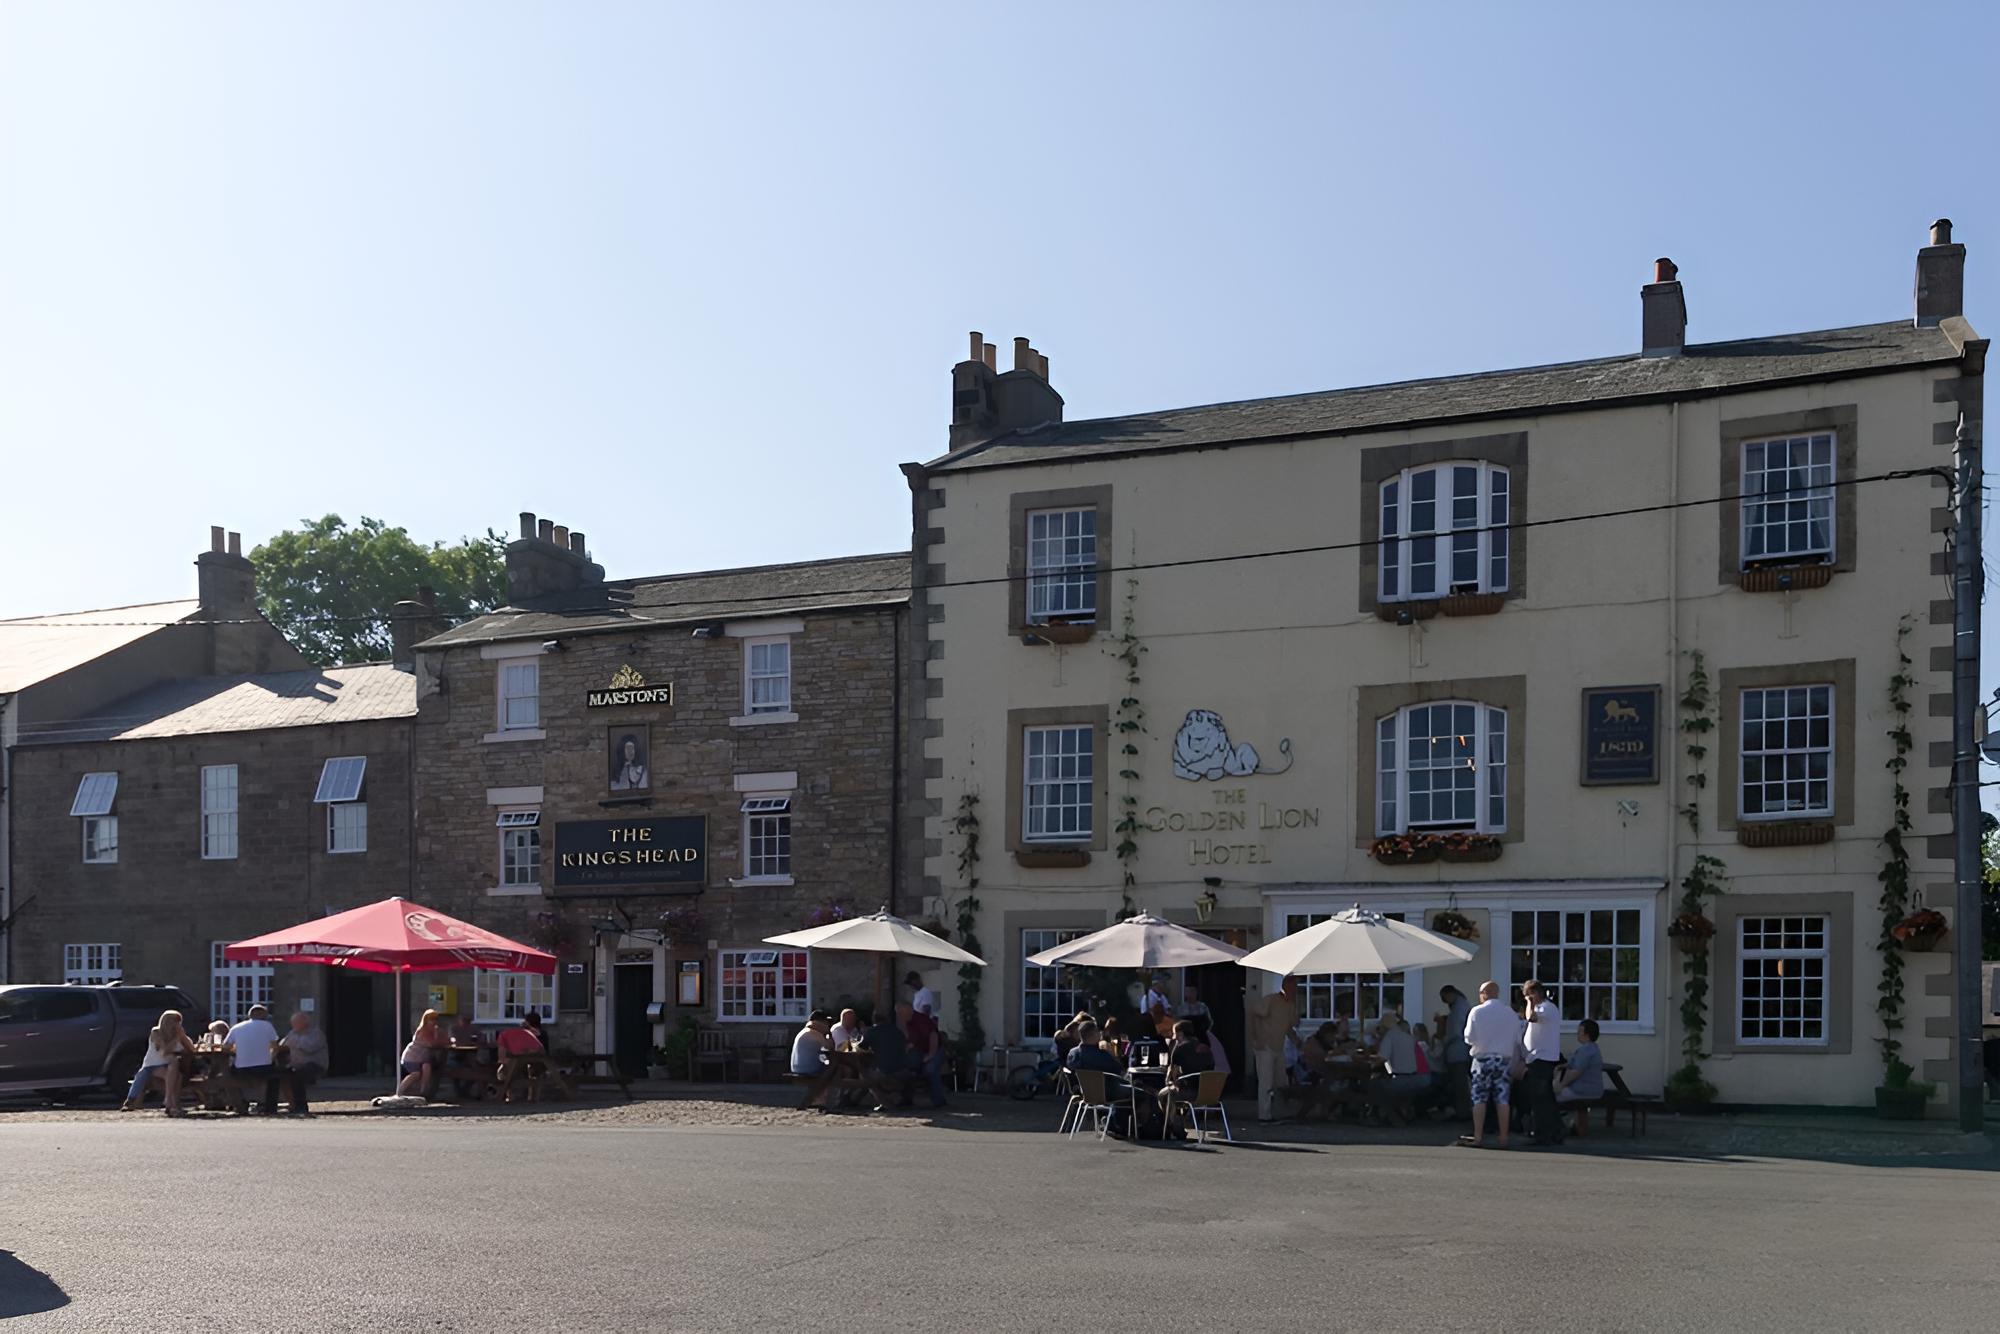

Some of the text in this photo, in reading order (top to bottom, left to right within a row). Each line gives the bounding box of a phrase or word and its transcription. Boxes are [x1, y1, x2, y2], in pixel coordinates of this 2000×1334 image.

[1212, 788, 1246, 804] THE
[1145, 802, 1320, 833] GOLDEN LION
[608, 827, 652, 843] THE
[1188, 838, 1272, 866] HOTEL
